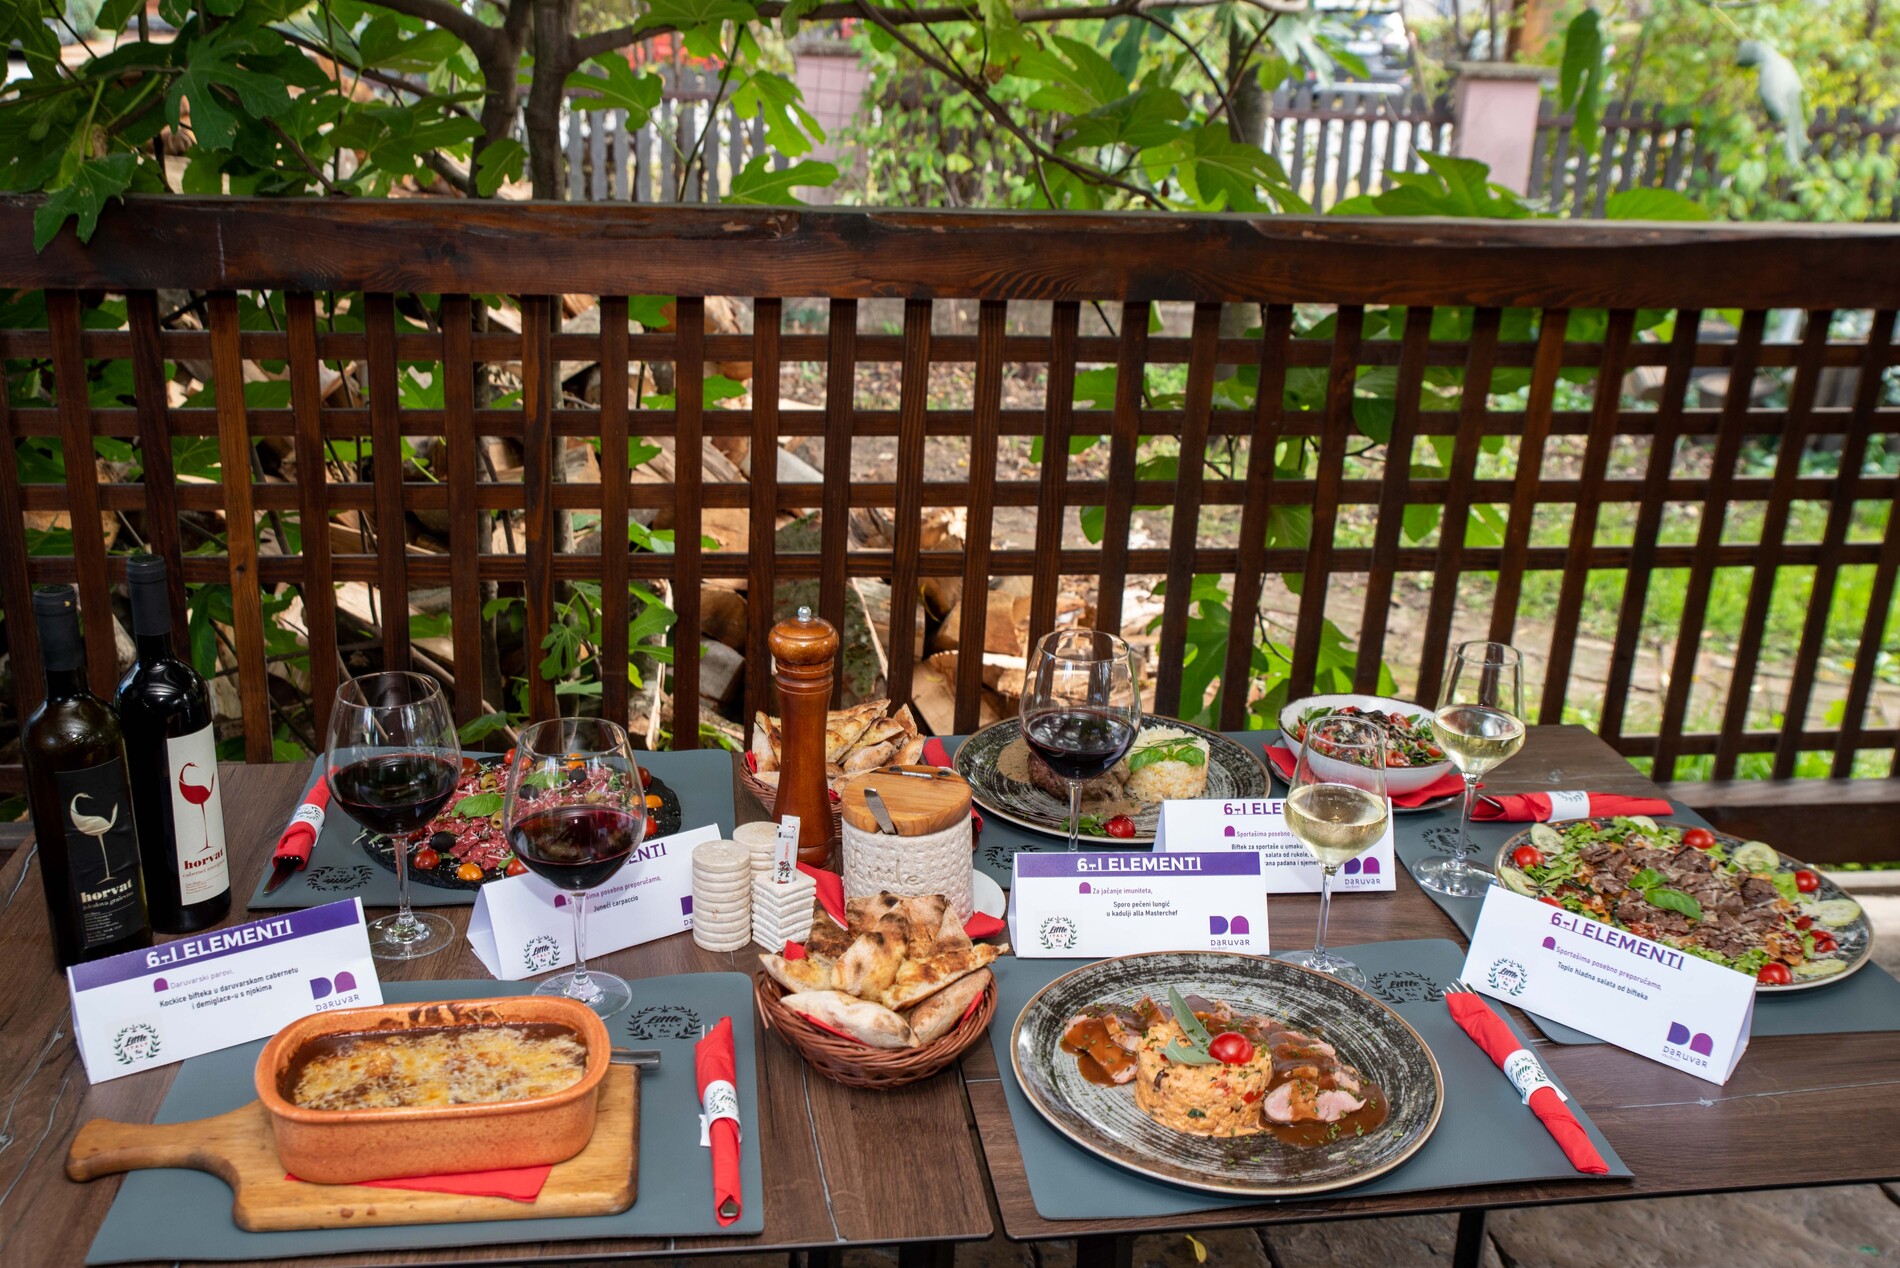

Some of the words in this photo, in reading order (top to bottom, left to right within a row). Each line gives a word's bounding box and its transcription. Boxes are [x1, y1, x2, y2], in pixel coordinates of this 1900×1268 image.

[1256, 843, 1279, 851] sportaše
[184, 848, 223, 870] horvat
[1108, 856, 1202, 871] ELEMENTI
[80, 879, 133, 903] horvat
[600, 885, 624, 898] posebno
[1092, 887, 1100, 895] Za
[1101, 887, 1122, 896] jačanje
[1123, 887, 1153, 895] imuniteta,
[612, 894, 639, 908] carpaccio
[1113, 901, 1131, 909] Sporo
[1132, 900, 1151, 909] pečeni
[1111, 910, 1132, 918] kadulji
[1145, 909, 1178, 917] Masterchef
[183, 918, 293, 959] ELEMENTI
[1583, 922, 1686, 970] ELEMENTI
[1556, 946, 1591, 964] Sportašima
[1591, 959, 1618, 975] posebno
[159, 995, 187, 1008] Kockice
[188, 989, 212, 1001] bifteka
[219, 976, 264, 992] daruvarskom
[265, 967, 299, 981] cabernetu
[170, 974, 210, 990] Daruvarski
[210, 969, 234, 981] parovi,
[1557, 961, 1574, 974] Toplo
[1574, 968, 1596, 982] hladna
[1596, 976, 1616, 989] salata
[1617, 984, 1626, 993] od
[1626, 986, 1649, 1001] bifteka
[246, 984, 272, 997] njokima
